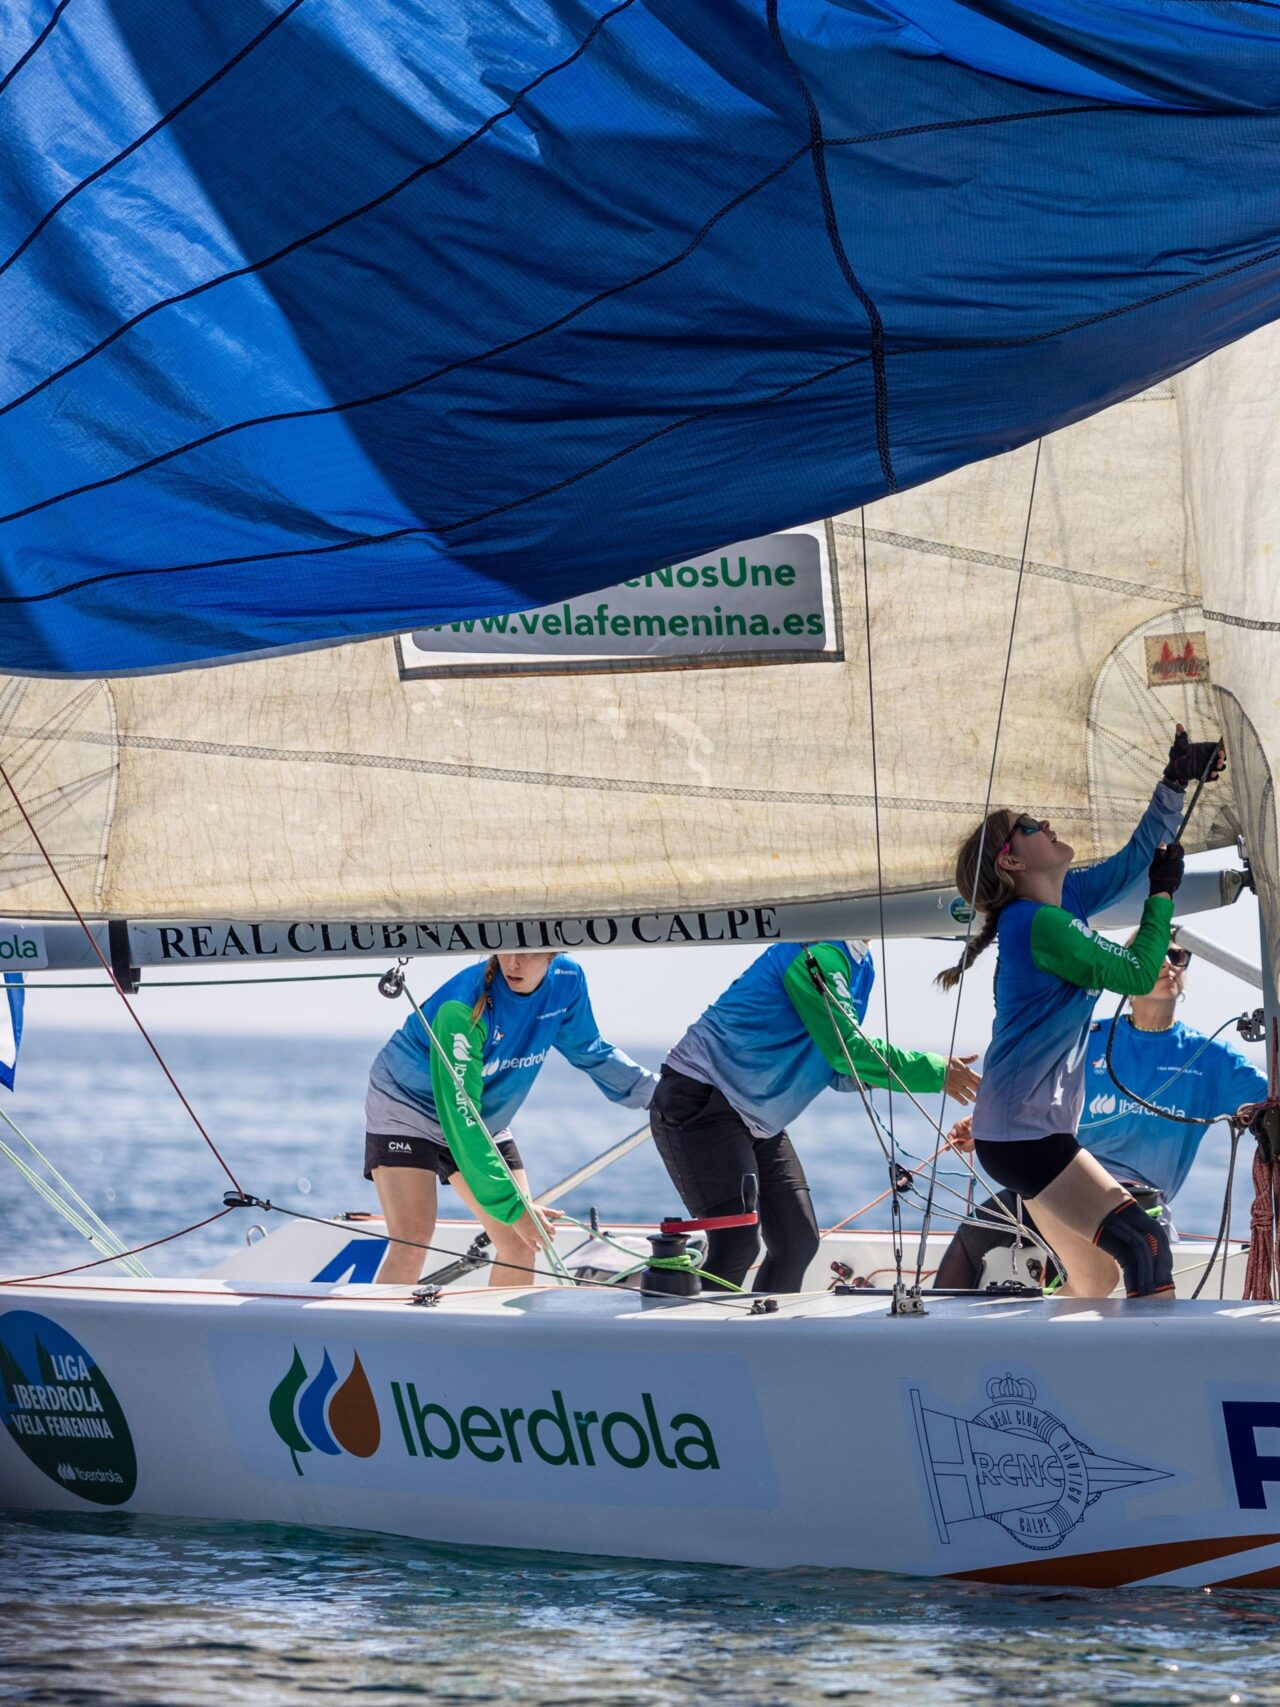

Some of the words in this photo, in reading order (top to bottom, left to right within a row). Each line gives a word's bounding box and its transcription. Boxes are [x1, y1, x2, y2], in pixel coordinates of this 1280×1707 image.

[624, 556, 796, 589] NosUne
[157, 923, 278, 959] REAL
[288, 922, 407, 951] CLUB
[632, 907, 782, 943] CALPE
[388, 1141, 412, 1151] CNA
[51, 1355, 92, 1381] LIGA
[13, 1384, 104, 1413] IBERDROLA
[11, 1414, 46, 1436] VELA
[48, 1416, 114, 1439] FEMENINA
[390, 1381, 720, 1470] Iberdrola
[75, 1467, 124, 1483] Iberdrola
[972, 1452, 1064, 1488] RCNC
[1019, 1516, 1052, 1533] CALPE
